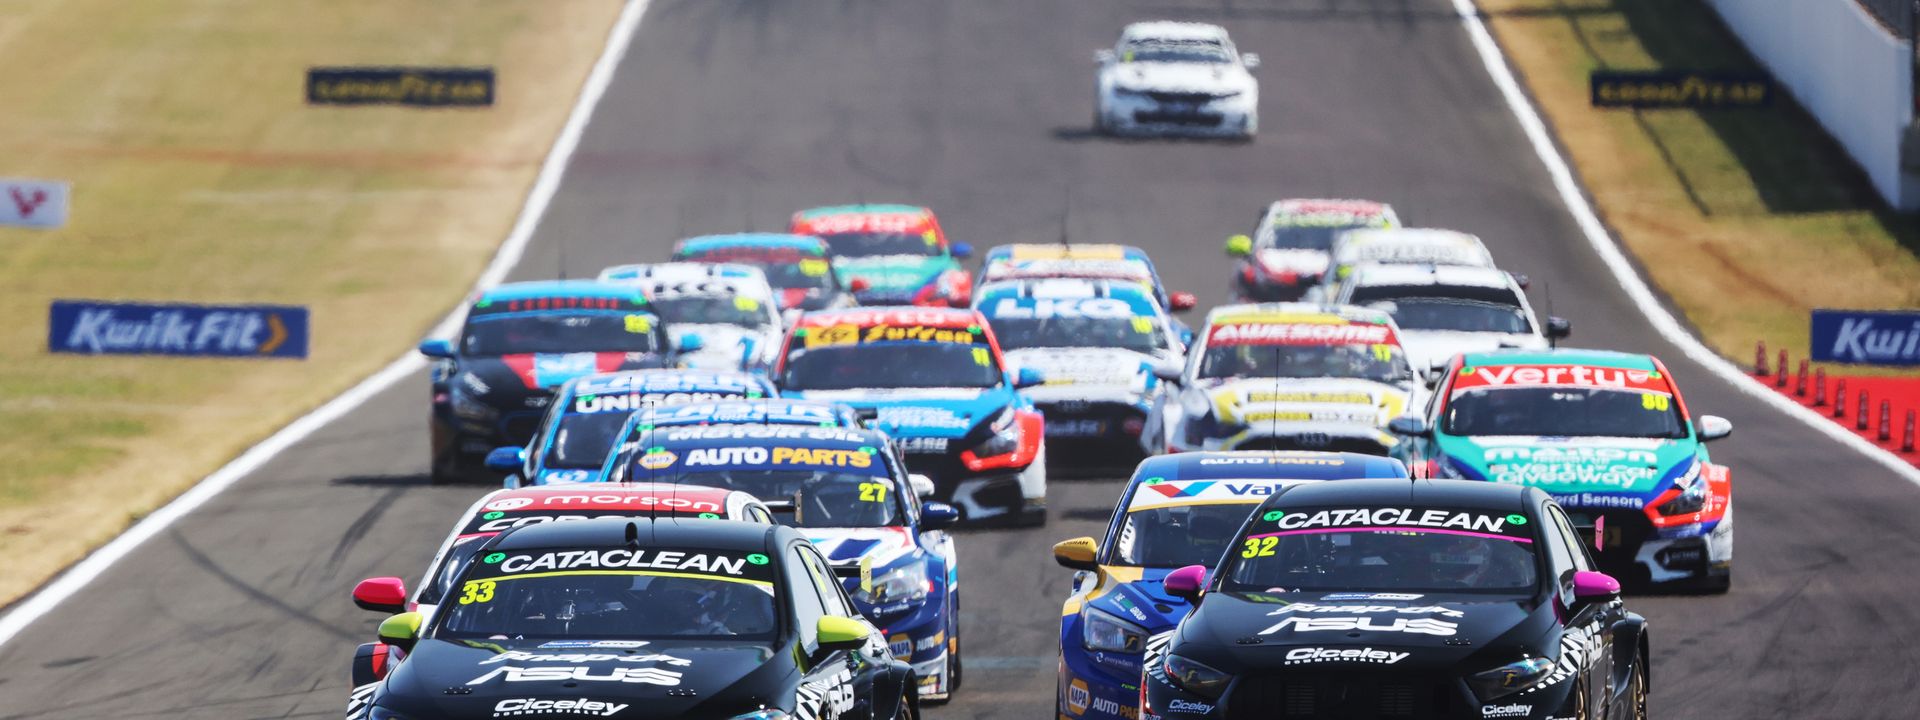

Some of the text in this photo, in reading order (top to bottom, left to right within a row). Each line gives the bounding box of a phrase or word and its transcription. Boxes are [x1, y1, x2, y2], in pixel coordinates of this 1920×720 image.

[994, 299, 1131, 319] LKQ
[67, 311, 262, 351] Kwik Fit
[1212, 324, 1389, 344] AWESOME
[1833, 318, 1920, 359] Kwi
[1641, 394, 1668, 411] 80
[686, 447, 873, 468] AUTO PARTS
[1200, 457, 1345, 467] AUTO PARTS
[858, 483, 887, 503] 27
[1224, 482, 1281, 496] Val
[544, 494, 719, 513] morson
[1278, 508, 1505, 533] CATACLEAN
[1241, 536, 1279, 559] 32
[500, 550, 746, 576] CATACLEAN
[459, 581, 497, 605] 33
[1257, 616, 1459, 637] ASUS
[1285, 647, 1411, 665] Ciceley
[465, 665, 684, 687] ASUS
[1070, 684, 1088, 710] NAPA
[1168, 699, 1216, 715] Ciceley
[493, 698, 629, 717] Ciceley
[1092, 697, 1119, 715] AUTO
[1119, 706, 1141, 720] PAR
[1481, 703, 1533, 716] Ciceley
